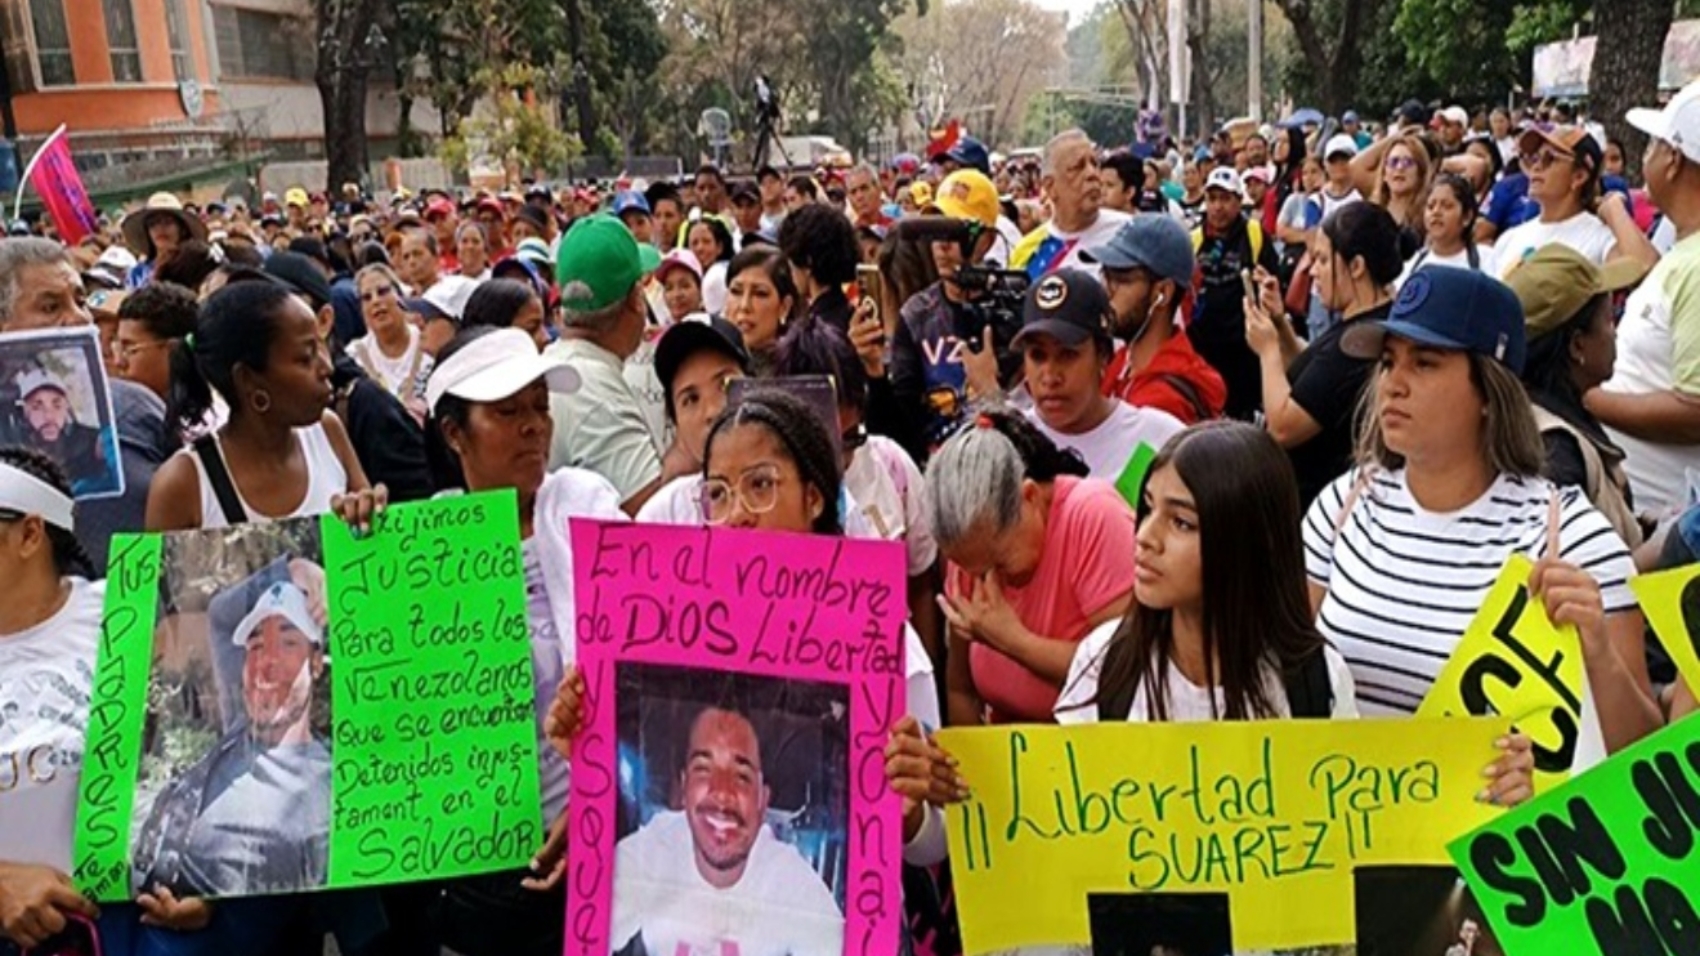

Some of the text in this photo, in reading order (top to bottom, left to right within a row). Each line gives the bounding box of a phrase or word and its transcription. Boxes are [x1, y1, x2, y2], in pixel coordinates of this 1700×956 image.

[362, 504, 486, 553] xijimos
[589, 522, 660, 581] En
[333, 617, 394, 658] Para
[408, 602, 486, 648] todos
[491, 597, 527, 643] los
[576, 584, 614, 645] de
[749, 600, 906, 677] Libertad
[344, 649, 532, 706] Venezolanos
[336, 717, 386, 748] Que
[335, 741, 454, 797] Detenidos
[441, 789, 475, 816] en
[494, 764, 522, 807] el
[1470, 795, 1627, 928] SIN
